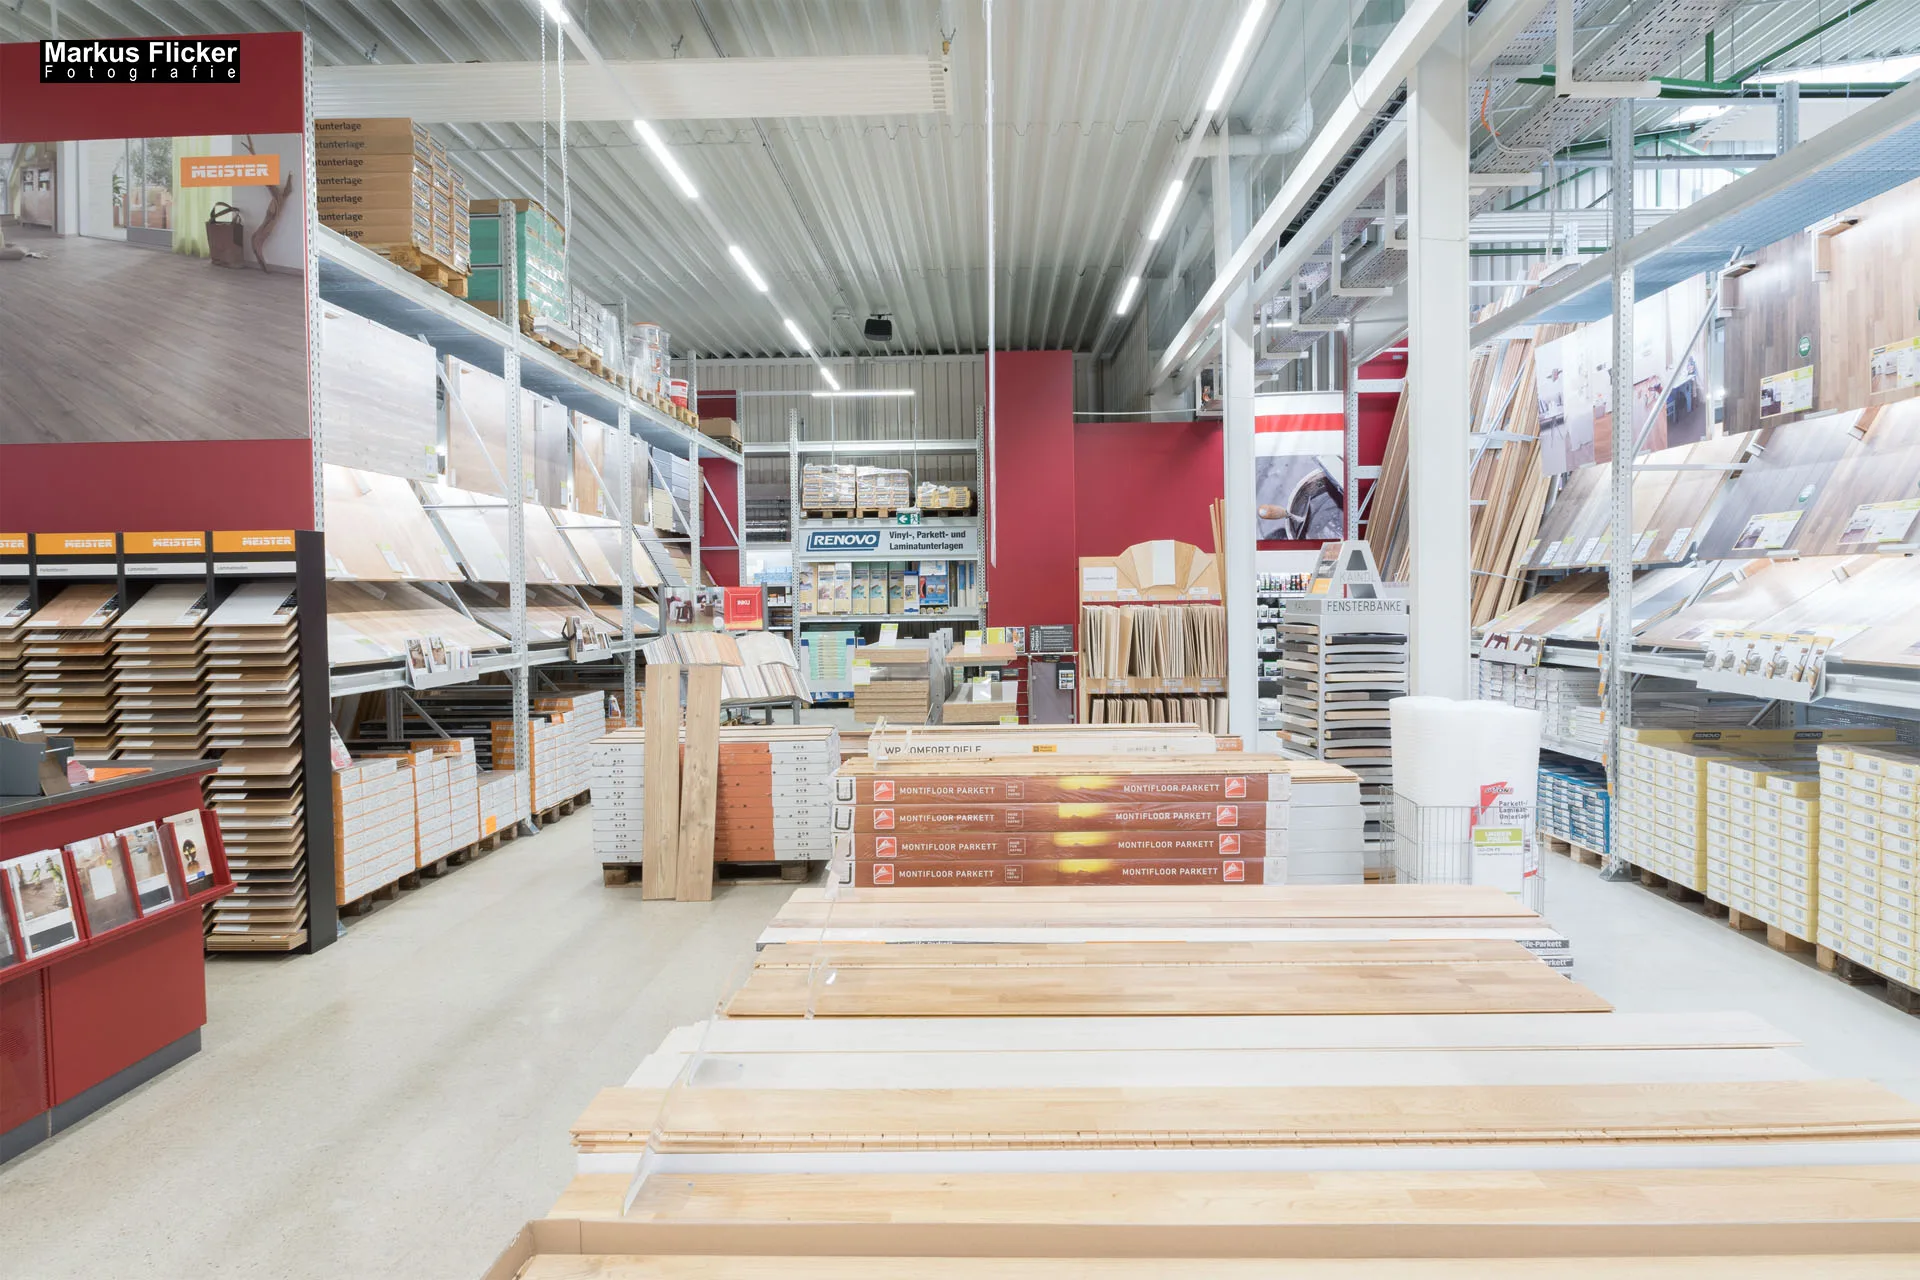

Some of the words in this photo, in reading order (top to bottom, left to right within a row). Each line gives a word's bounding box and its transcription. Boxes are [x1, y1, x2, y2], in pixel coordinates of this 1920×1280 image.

[316, 158, 364, 168] tunterlage
[192, 164, 269, 178] MEISTER
[889, 531, 915, 540] Vinyl-,
[916, 530, 949, 538] Parkett-
[950, 530, 966, 538] und
[64, 539, 113, 549] MEISTER
[152, 537, 202, 548] MEISTER
[242, 536, 292, 547] MEISTER
[813, 534, 878, 546] RENOVO
[889, 542, 964, 551] Laminatunterlagen
[1340, 571, 1376, 582] KAINDL
[908, 746, 950, 754] OMFORT
[1123, 784, 1178, 792] MONTIFLOOR
[1181, 784, 1220, 792] PARKETT
[899, 814, 954, 822] MONTIFLOOR
[1115, 812, 1170, 820] MONTIFLOOR
[1175, 840, 1214, 848] PARKETT
[899, 870, 953, 878] MONTIFLOOR
[1180, 867, 1218, 875] PARKETT
